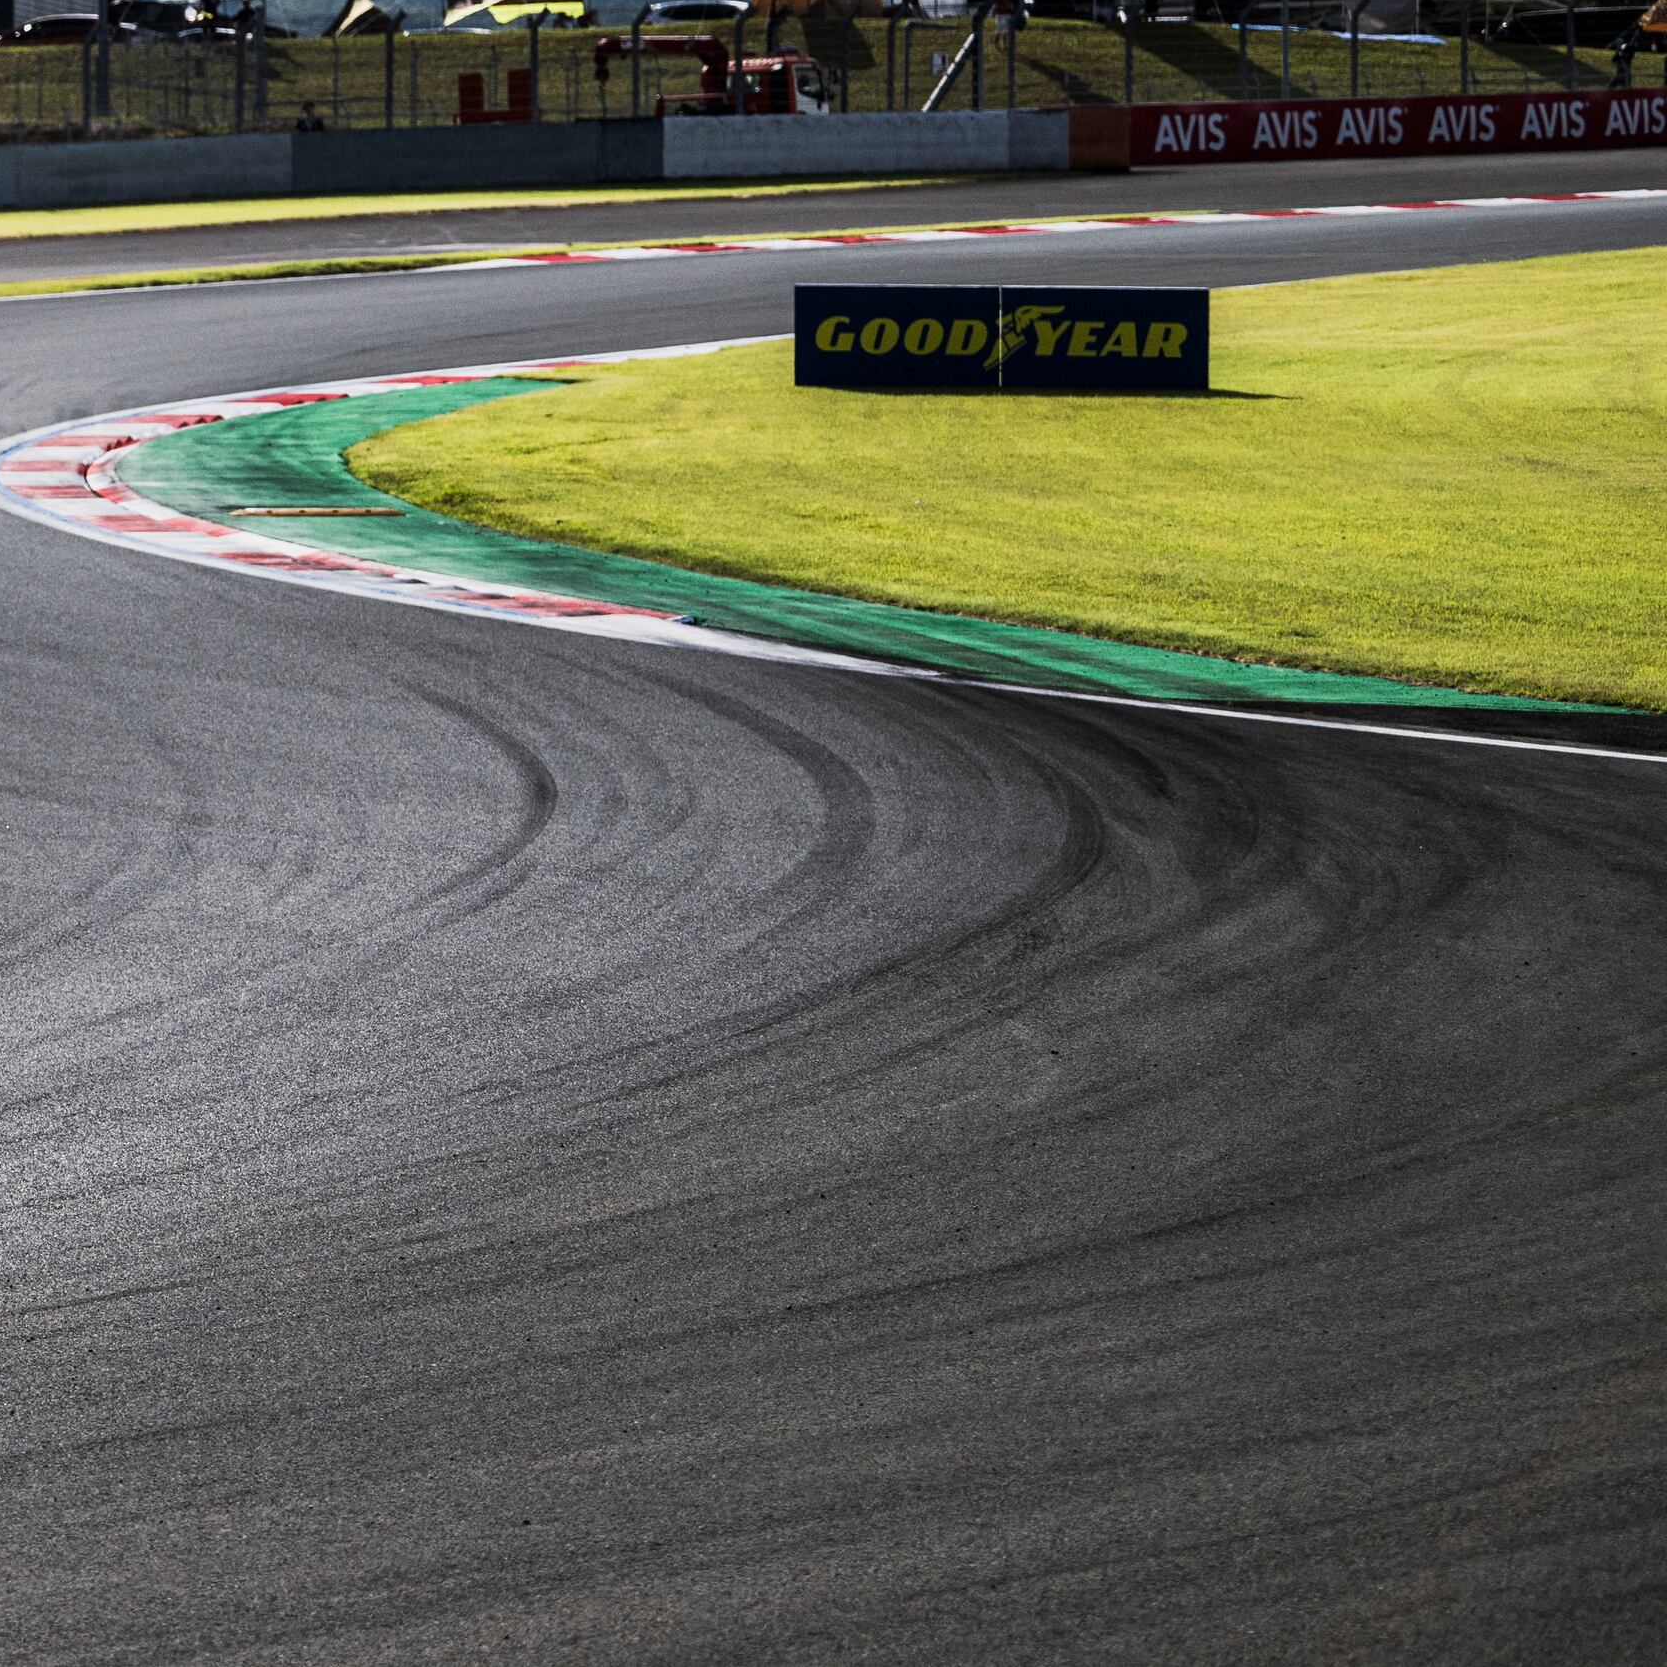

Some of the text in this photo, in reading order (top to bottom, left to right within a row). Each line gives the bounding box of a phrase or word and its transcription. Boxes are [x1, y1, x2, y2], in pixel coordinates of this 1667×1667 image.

[1154, 114, 1226, 153] AVIS
[1252, 110, 1318, 150] AVIS
[1336, 107, 1403, 145] AVIS
[1428, 104, 1495, 144] AVIS
[1520, 100, 1584, 140] AVIS
[1604, 97, 1666, 137] AVIS
